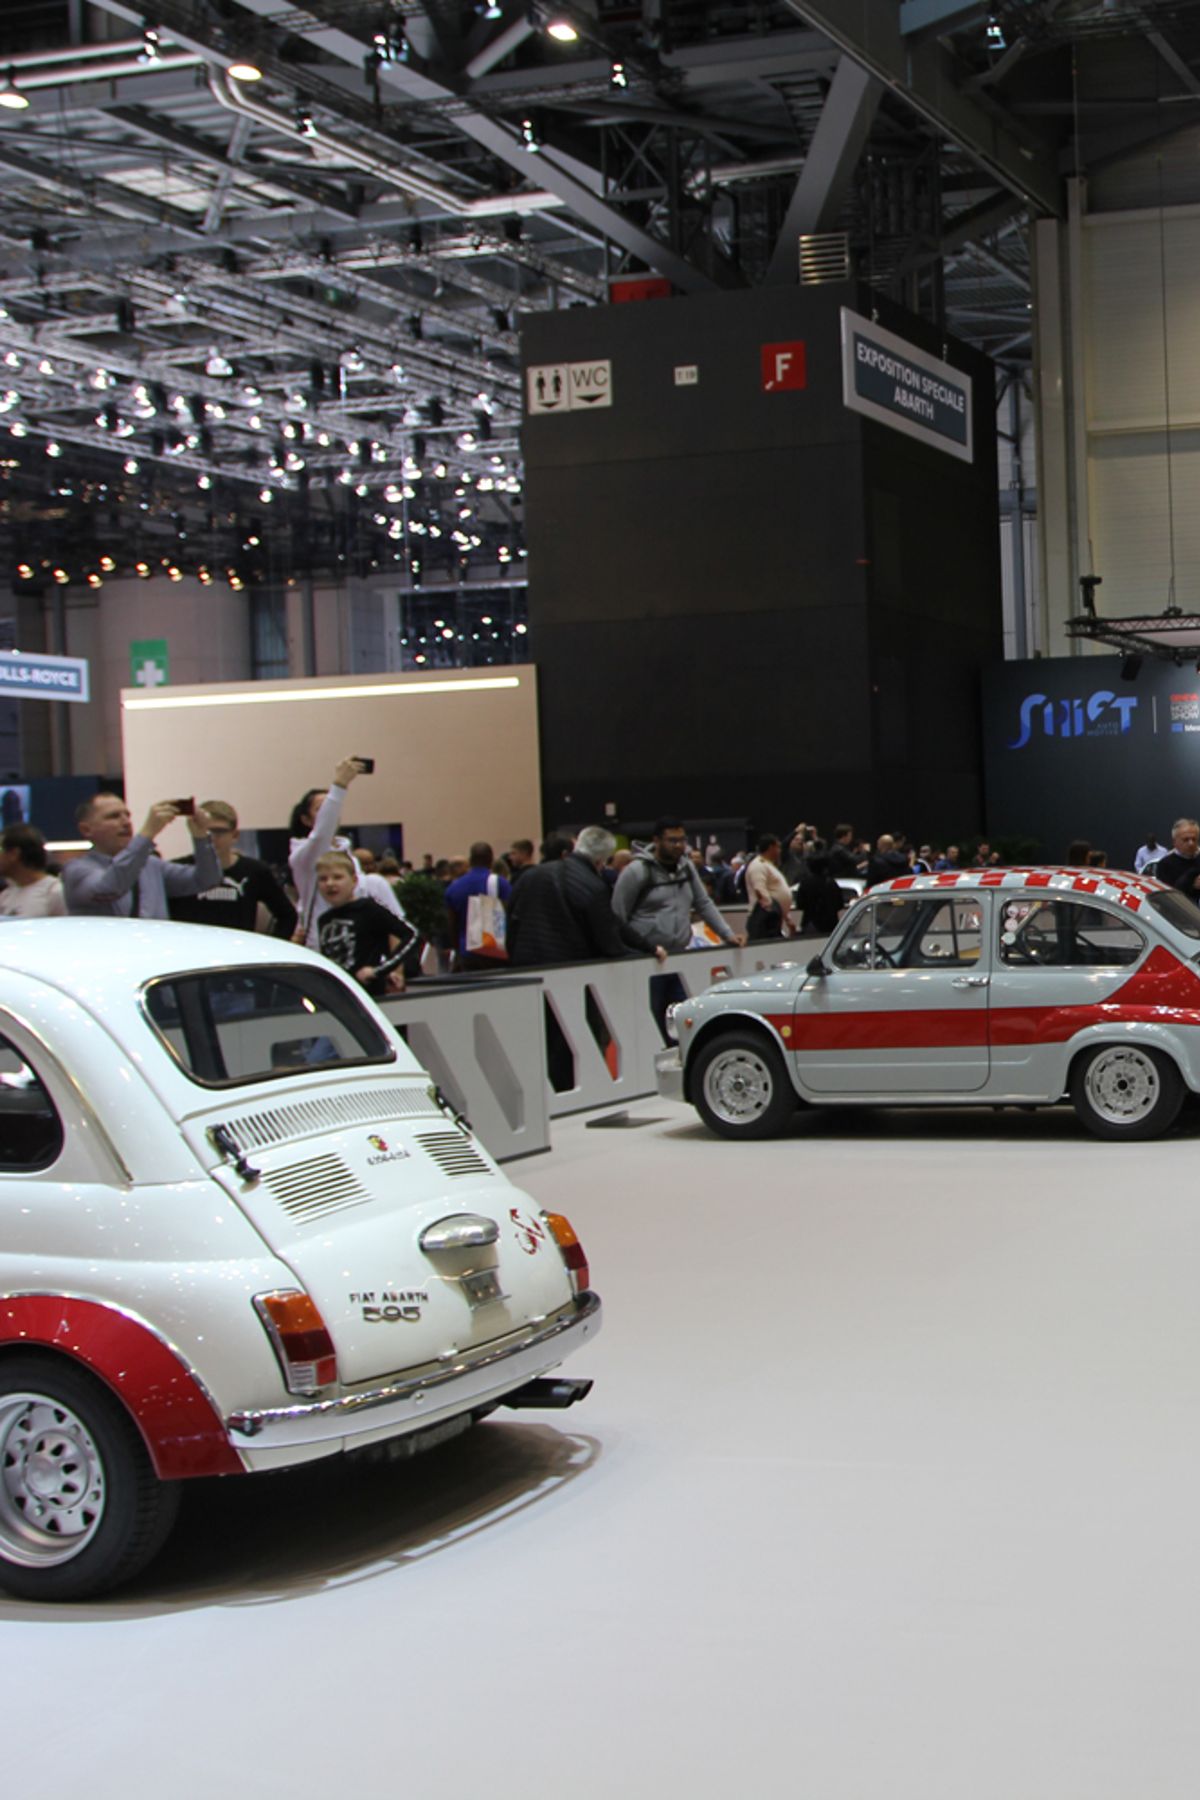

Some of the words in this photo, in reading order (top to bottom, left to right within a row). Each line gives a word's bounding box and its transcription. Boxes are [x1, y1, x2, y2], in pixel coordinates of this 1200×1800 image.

[572, 366, 608, 388] WC
[776, 353, 793, 382] F
[857, 341, 921, 391] EXPOSITION
[921, 376, 965, 413] SPECIALE
[894, 386, 935, 420] ABARTH
[349, 1291, 375, 1304] FIAT
[382, 1291, 429, 1304] ABARTH
[362, 1305, 421, 1323] 595
